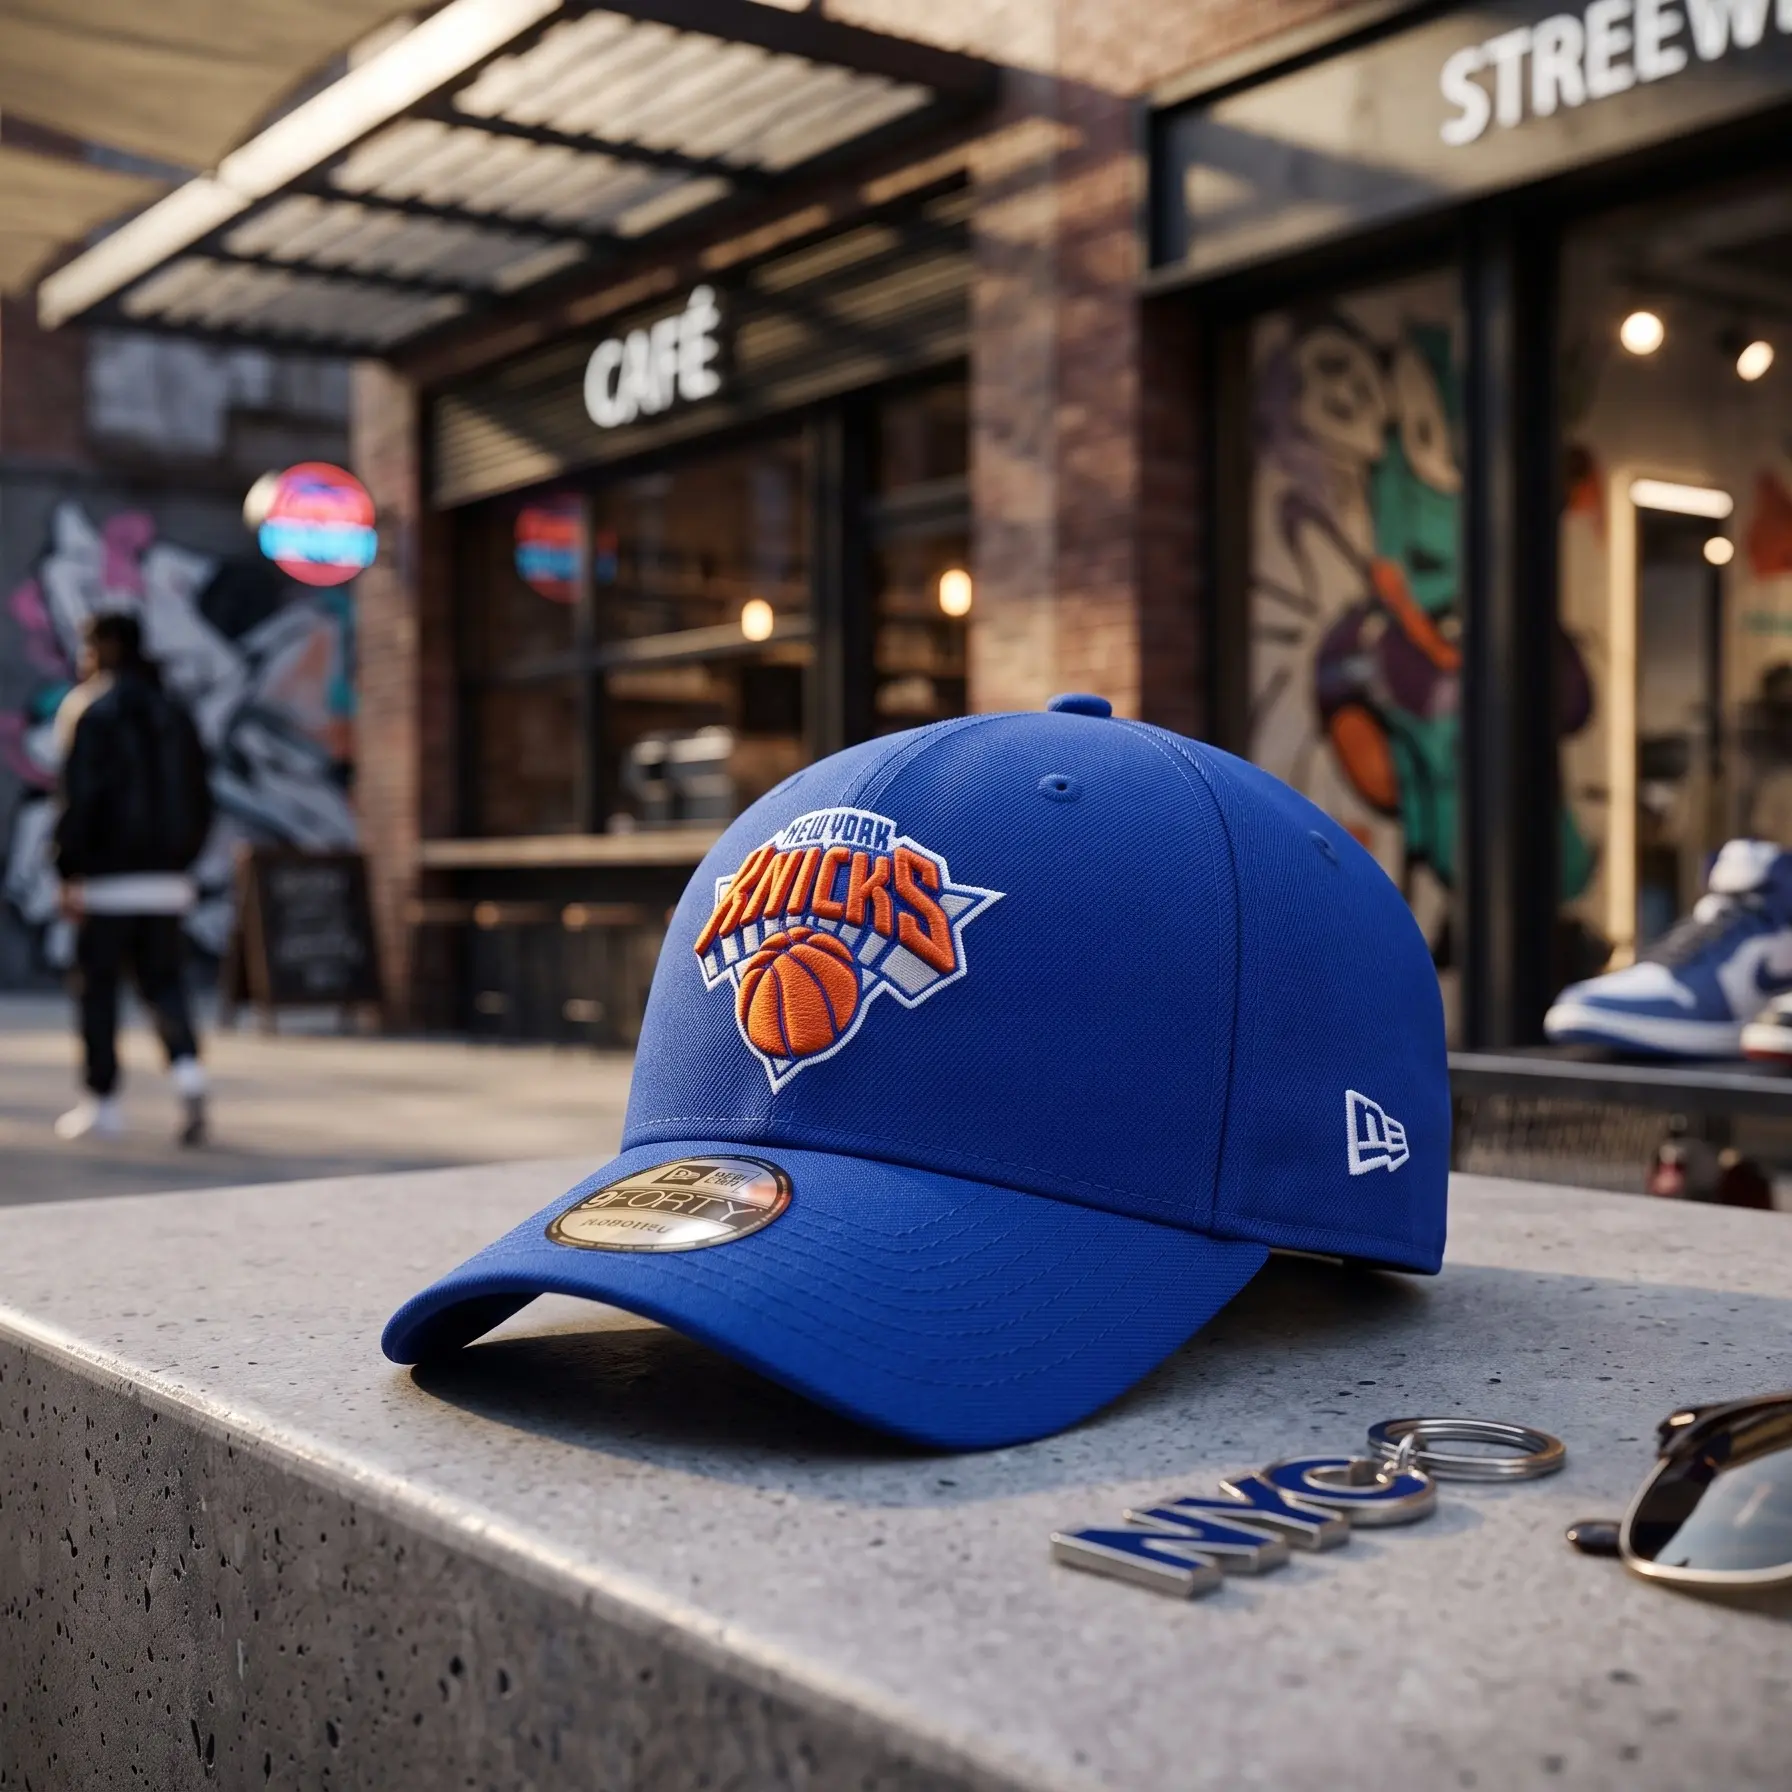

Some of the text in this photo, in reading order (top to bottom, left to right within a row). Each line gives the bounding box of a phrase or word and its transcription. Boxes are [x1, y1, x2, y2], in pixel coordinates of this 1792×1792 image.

[1440, 0, 1792, 146] STREEW
[584, 284, 720, 428] CAFÉ
[782, 813, 892, 851] NEW YORK
[694, 846, 955, 974] KNICKS
[580, 1190, 757, 1222] 9FORTY
[1051, 1453, 1438, 1599] NYC
